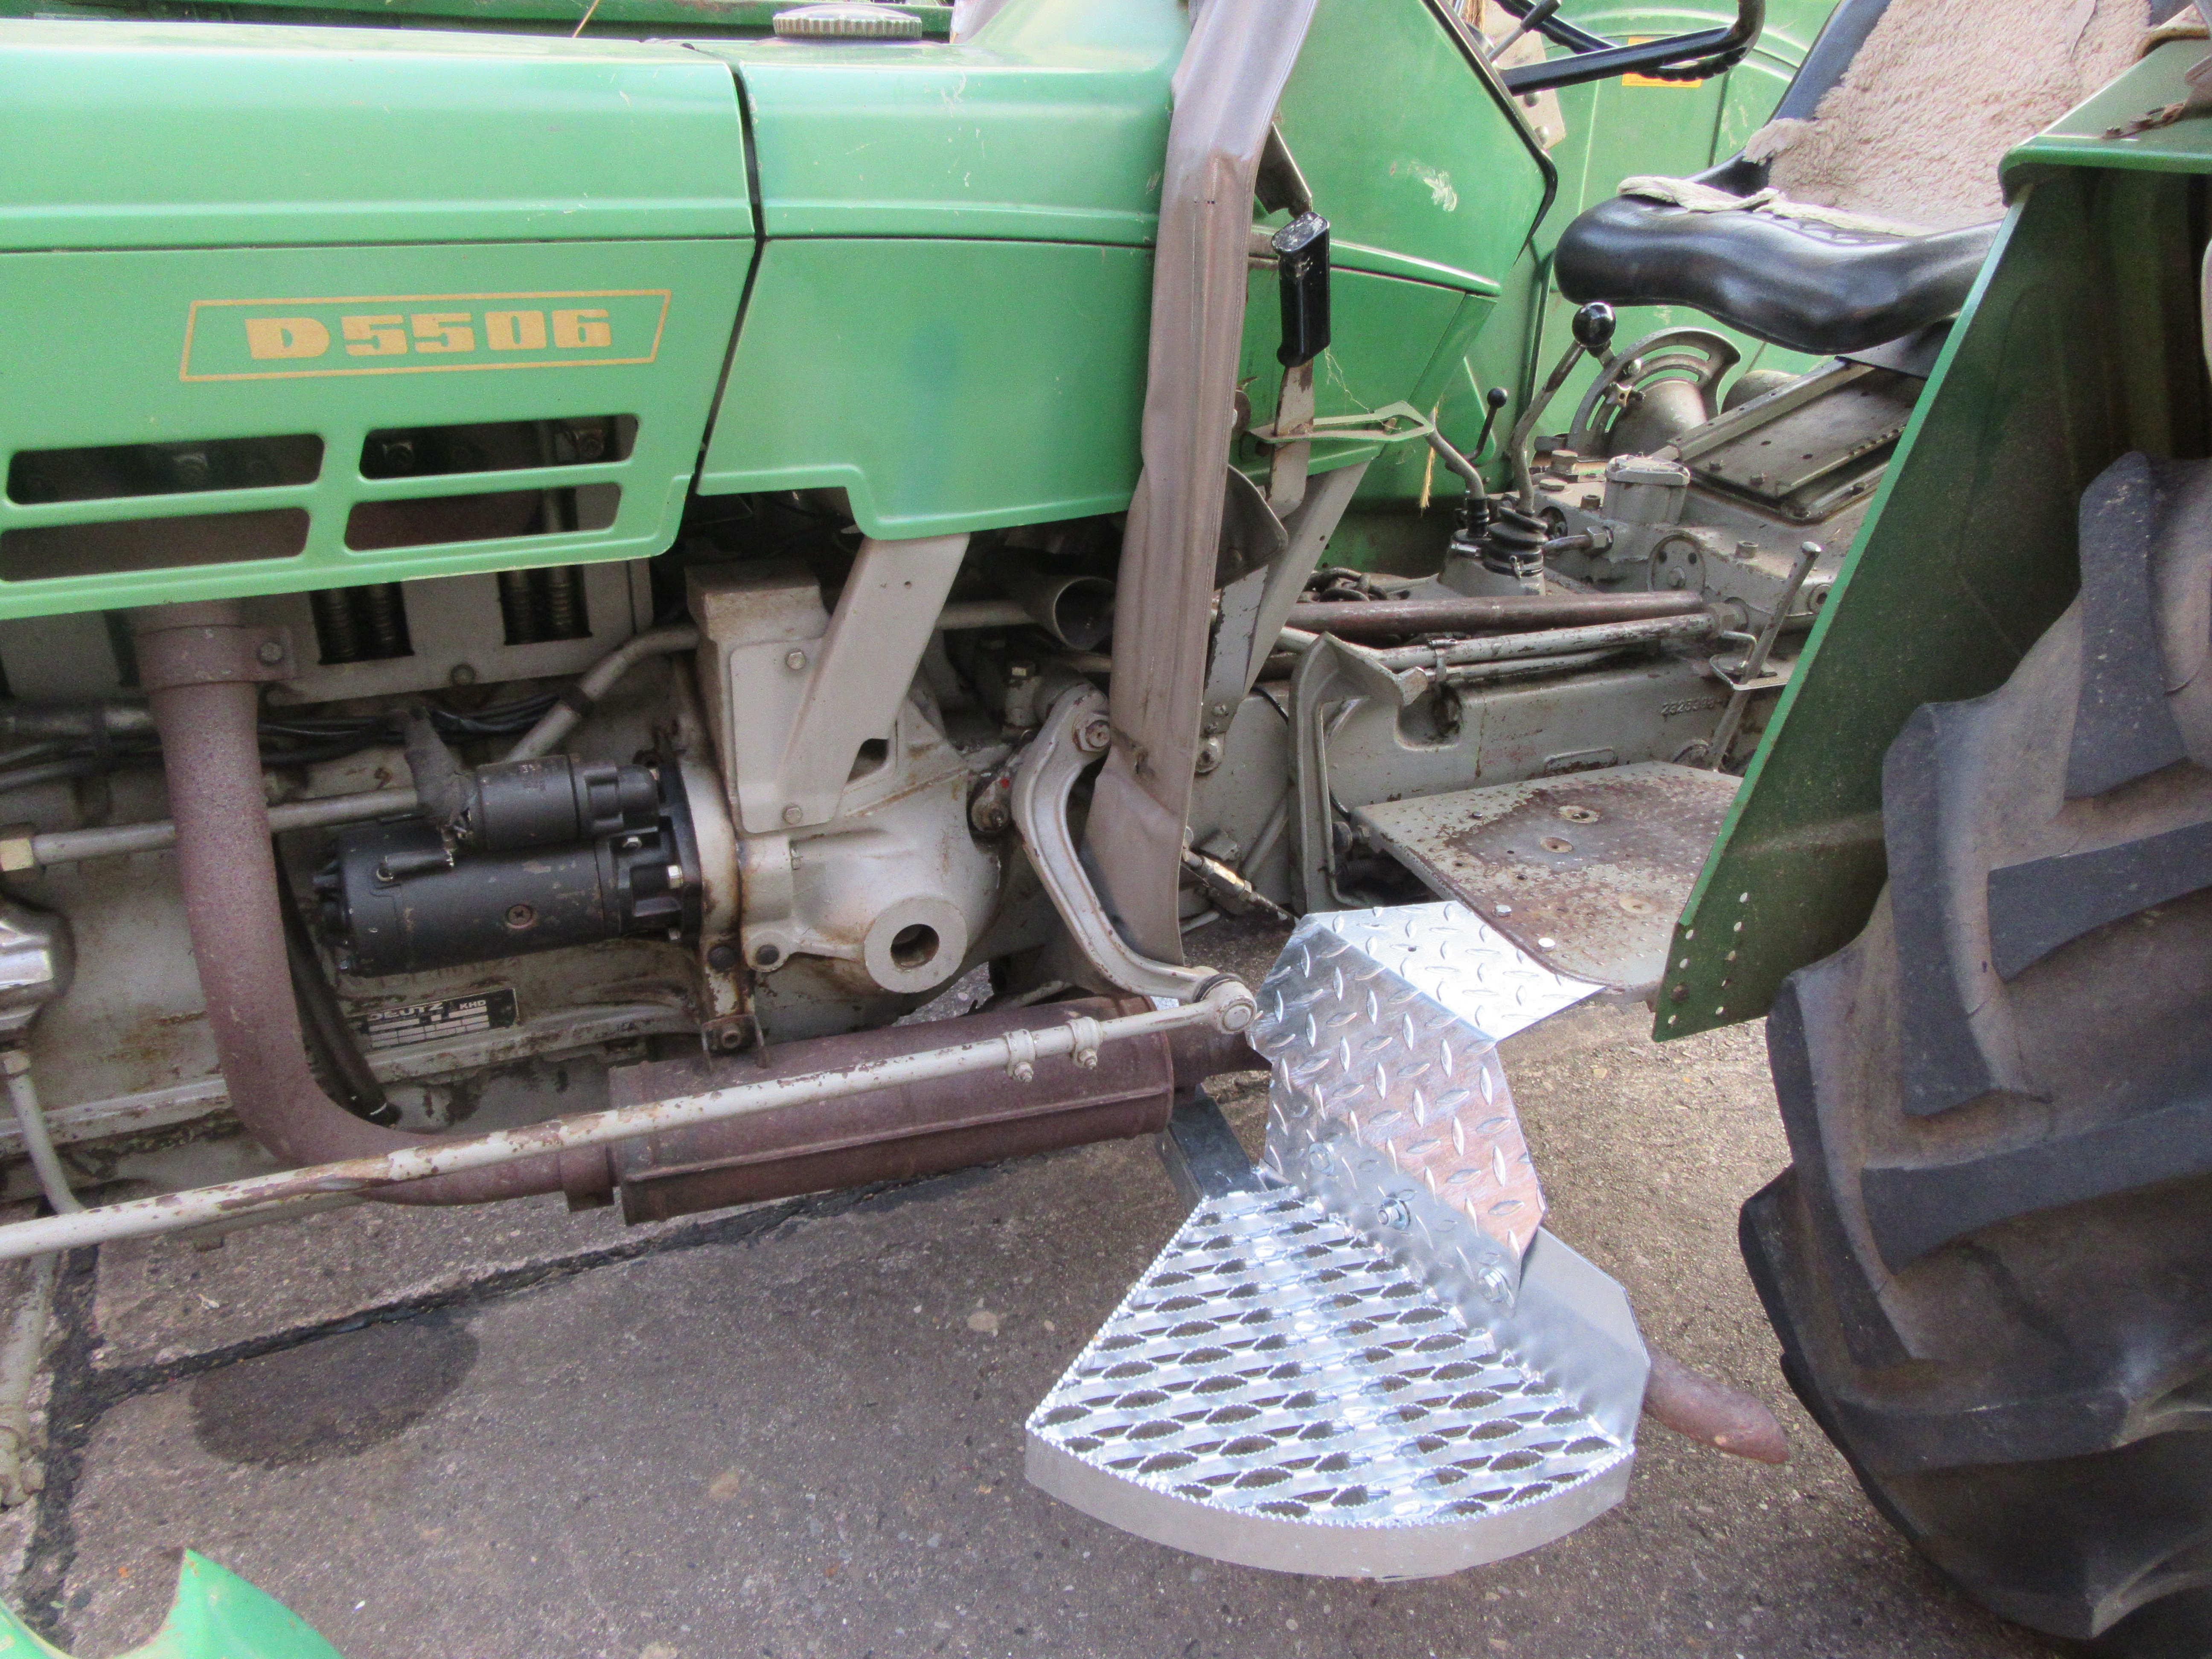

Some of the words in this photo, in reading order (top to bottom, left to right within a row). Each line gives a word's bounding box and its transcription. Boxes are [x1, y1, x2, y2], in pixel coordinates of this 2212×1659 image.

[244, 309, 611, 359] D5506
[368, 1002, 443, 1021] DEUTZ
[460, 999, 486, 1010] KHD
